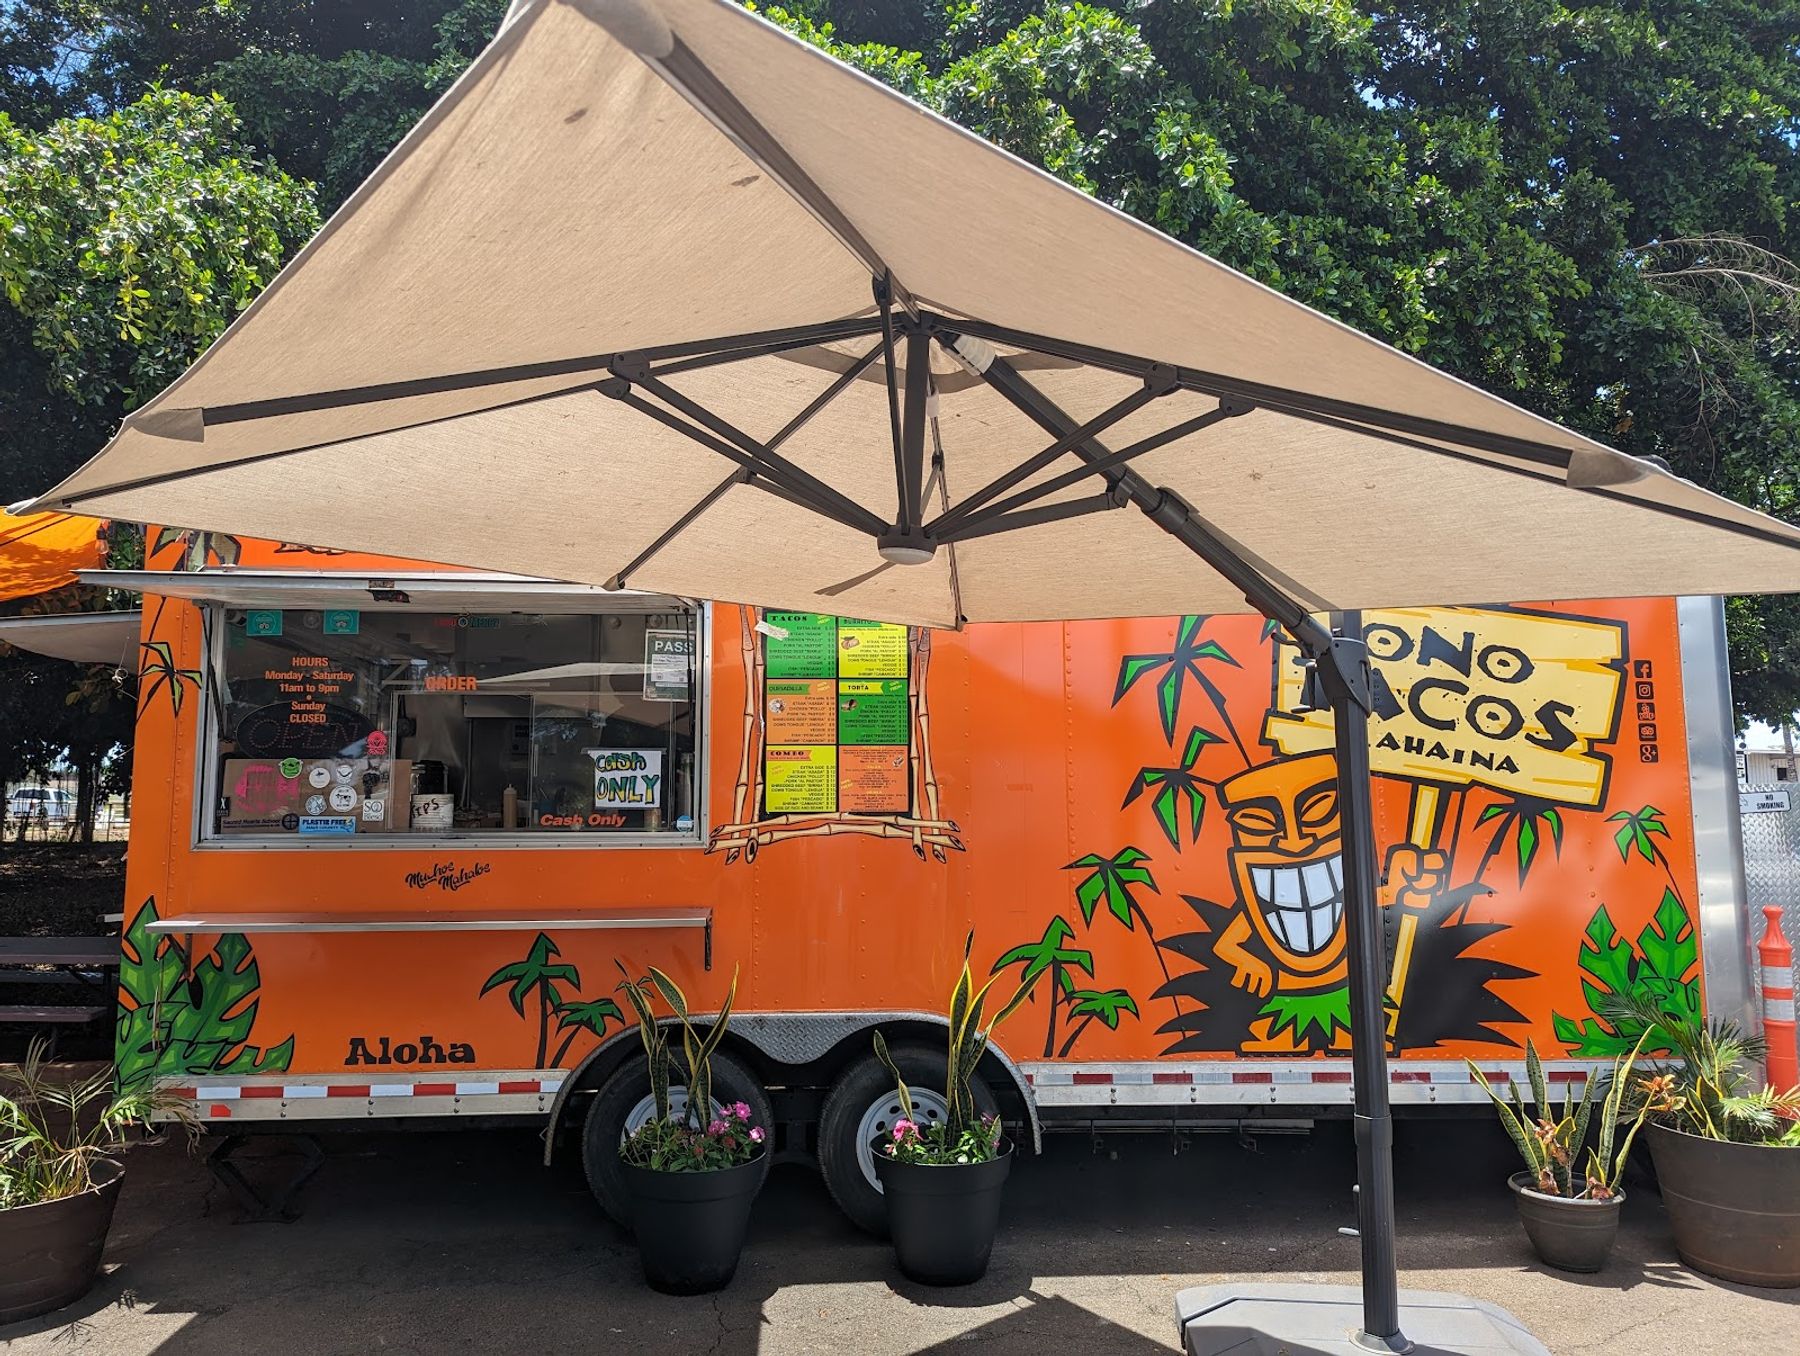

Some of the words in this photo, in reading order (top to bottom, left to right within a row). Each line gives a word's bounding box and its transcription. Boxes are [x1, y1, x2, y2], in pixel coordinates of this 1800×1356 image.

[654, 640, 693, 652] PASS
[1362, 623, 1535, 684] ONO
[292, 657, 328, 666] HOURS
[265, 670, 303, 681] Monday
[312, 670, 354, 682] Saturday
[280, 684, 303, 692] 11am
[306, 684, 316, 692] to
[318, 684, 340, 694] 9pm
[424, 676, 477, 690] ORDER
[291, 701, 326, 712] Sunday
[290, 714, 326, 724] CLOSED
[1368, 732, 1520, 774] AHAINA
[596, 774, 660, 804] ONLY
[1757, 802, 1784, 810] SMOKING
[540, 814, 584, 826] Cash
[588, 814, 627, 828] Only
[405, 862, 454, 888] Muchos
[344, 1036, 476, 1065] Aloha
